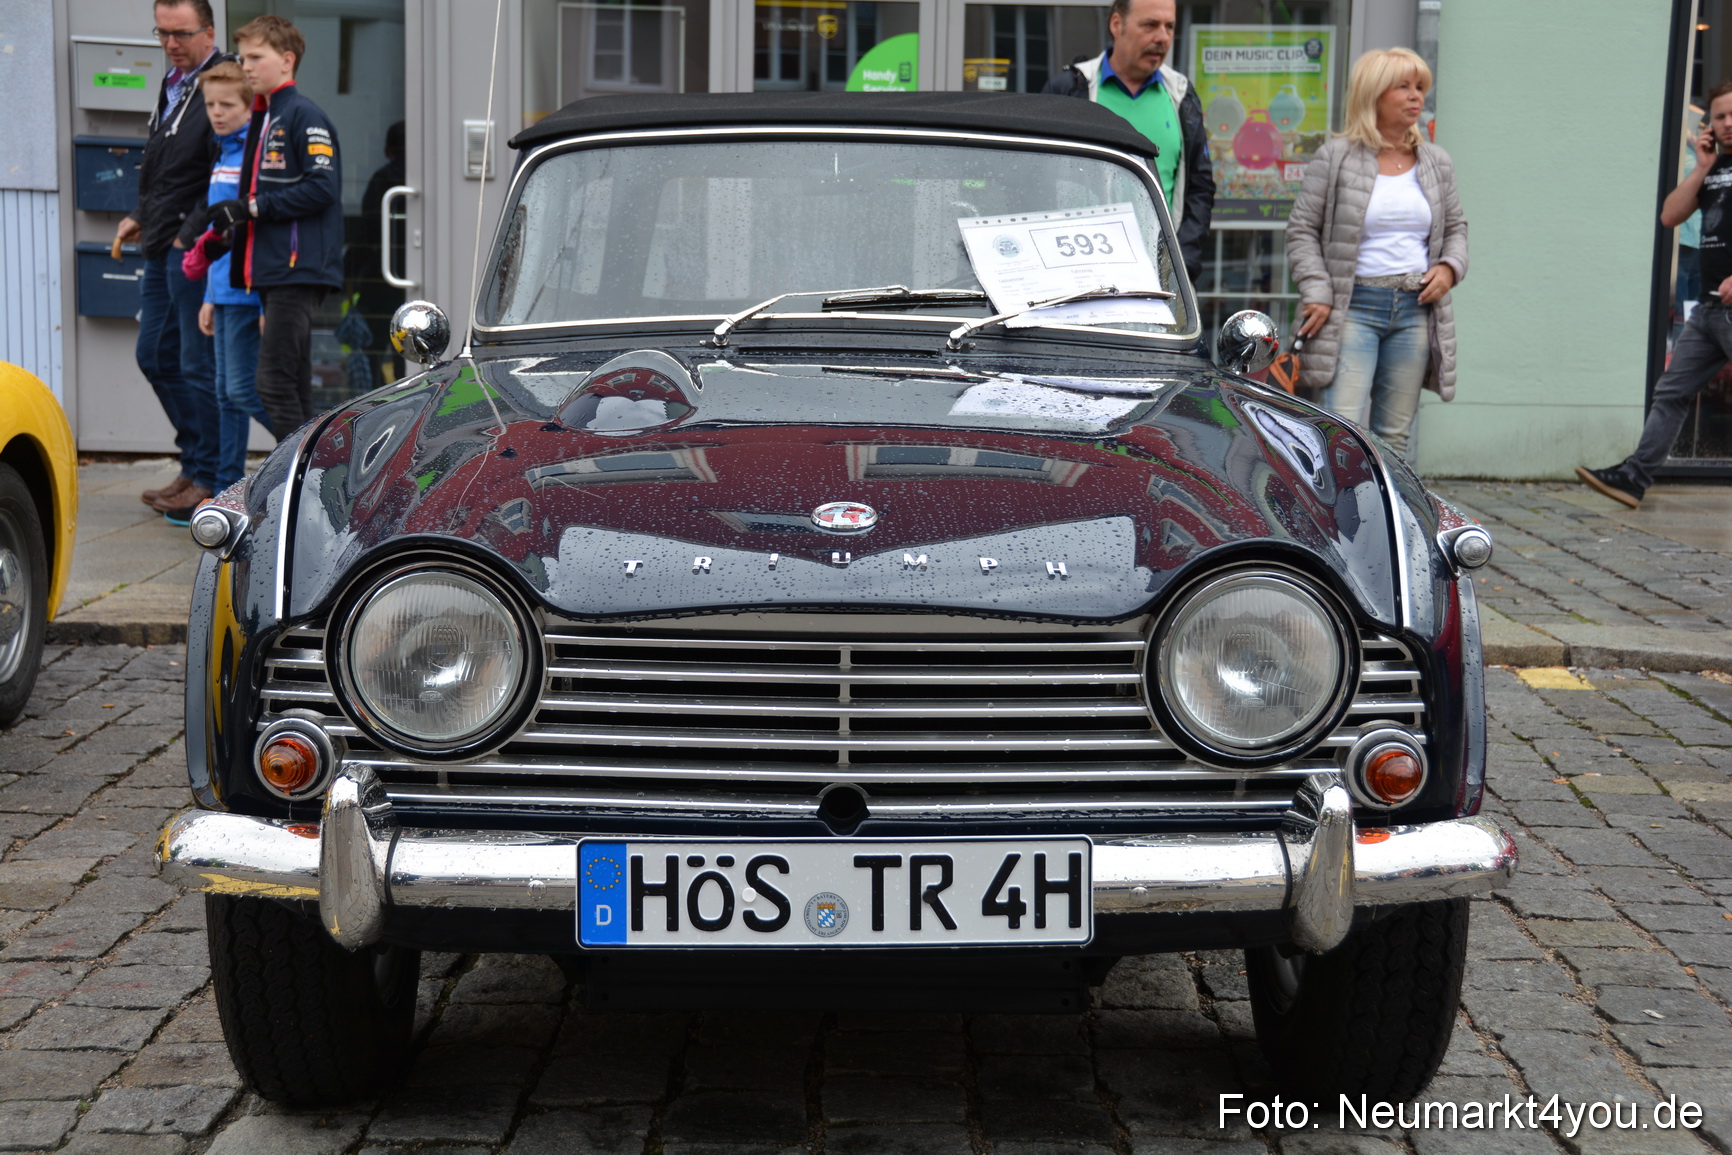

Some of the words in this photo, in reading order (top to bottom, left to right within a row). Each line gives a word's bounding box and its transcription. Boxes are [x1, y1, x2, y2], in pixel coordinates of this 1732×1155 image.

[1204, 49, 1232, 61] DEIN
[1235, 49, 1273, 61] MUSIC
[862, 68, 898, 84] Handy
[1055, 232, 1114, 257] 593
[623, 551, 1069, 579] TRIUMPH
[630, 853, 791, 932] HÖS
[853, 853, 958, 931] TR
[981, 852, 1082, 929] 4H
[595, 904, 612, 926] D
